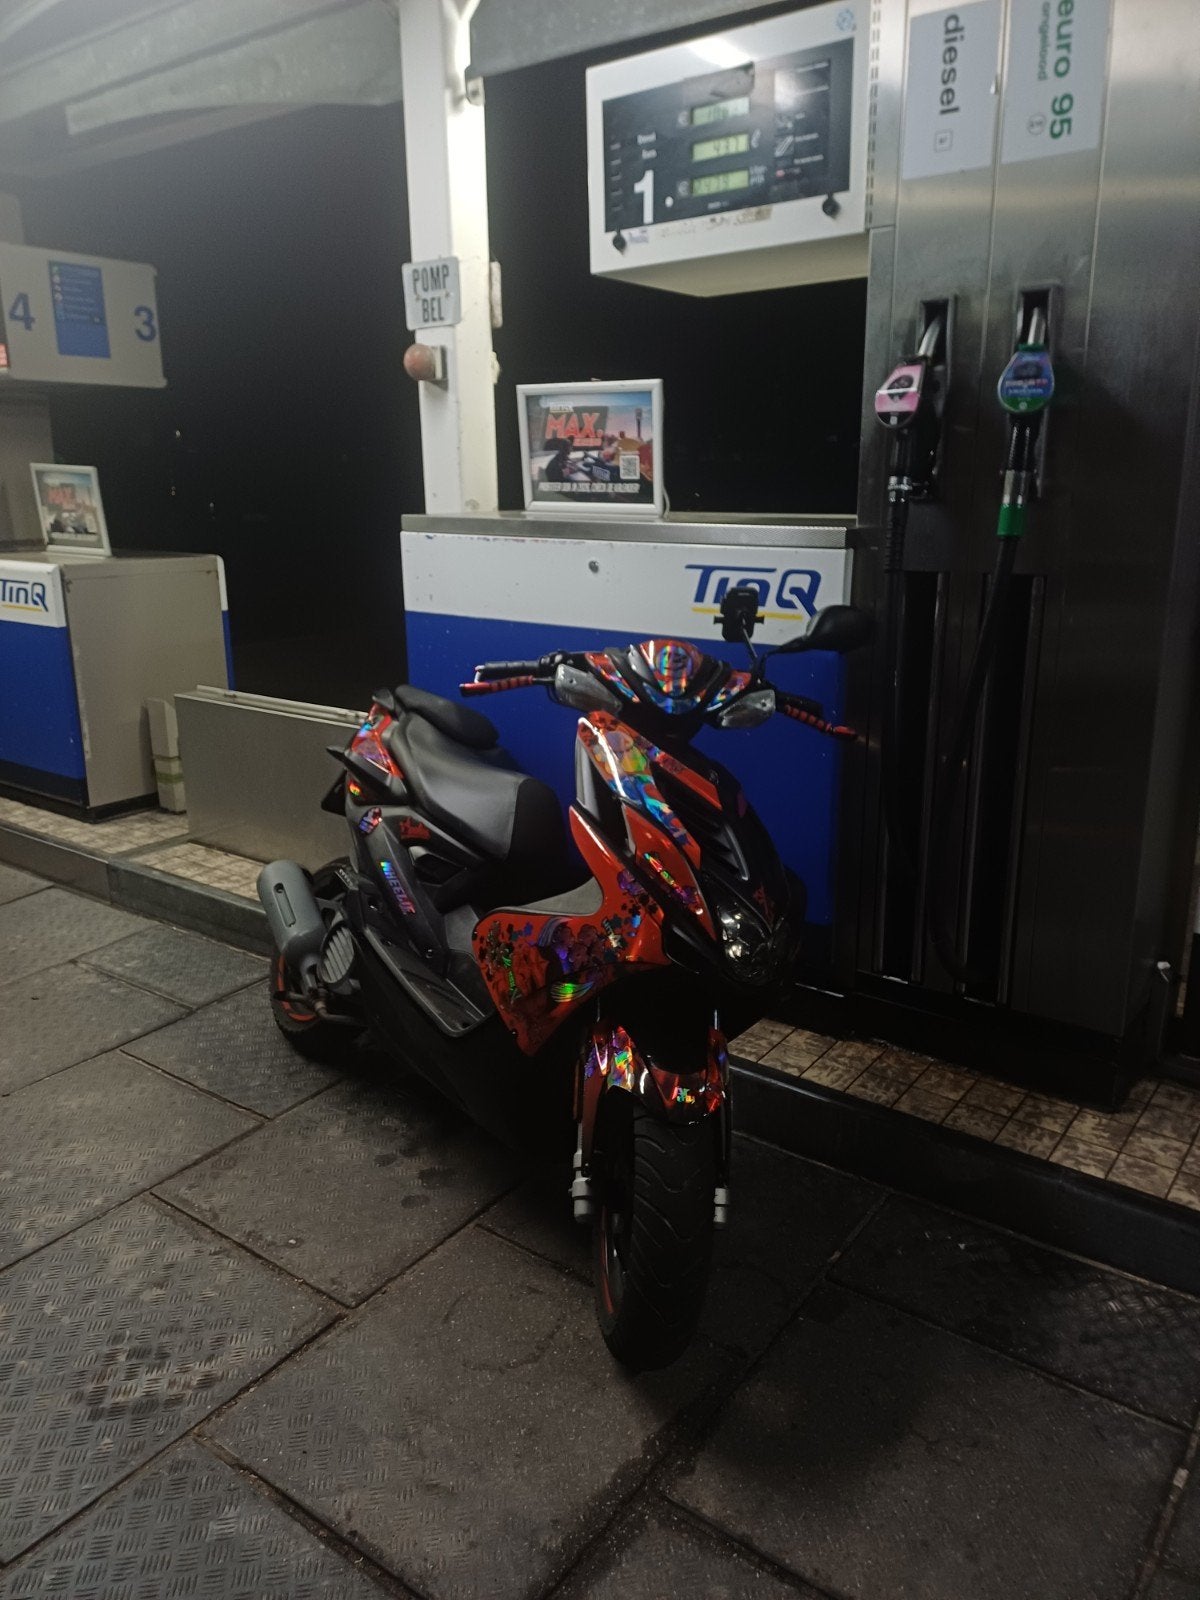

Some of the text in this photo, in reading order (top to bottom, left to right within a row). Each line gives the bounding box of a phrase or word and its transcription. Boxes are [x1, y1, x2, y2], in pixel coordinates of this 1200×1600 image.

[939, 13, 965, 116] diesel
[1049, 0, 1075, 140] euro 95
[633, 169, 655, 225] 1
[412, 264, 450, 295] POMP
[8, 292, 36, 331] 4
[133, 305, 157, 342] 3
[421, 297, 445, 323] BEL
[0, 578, 49, 612] TinQ
